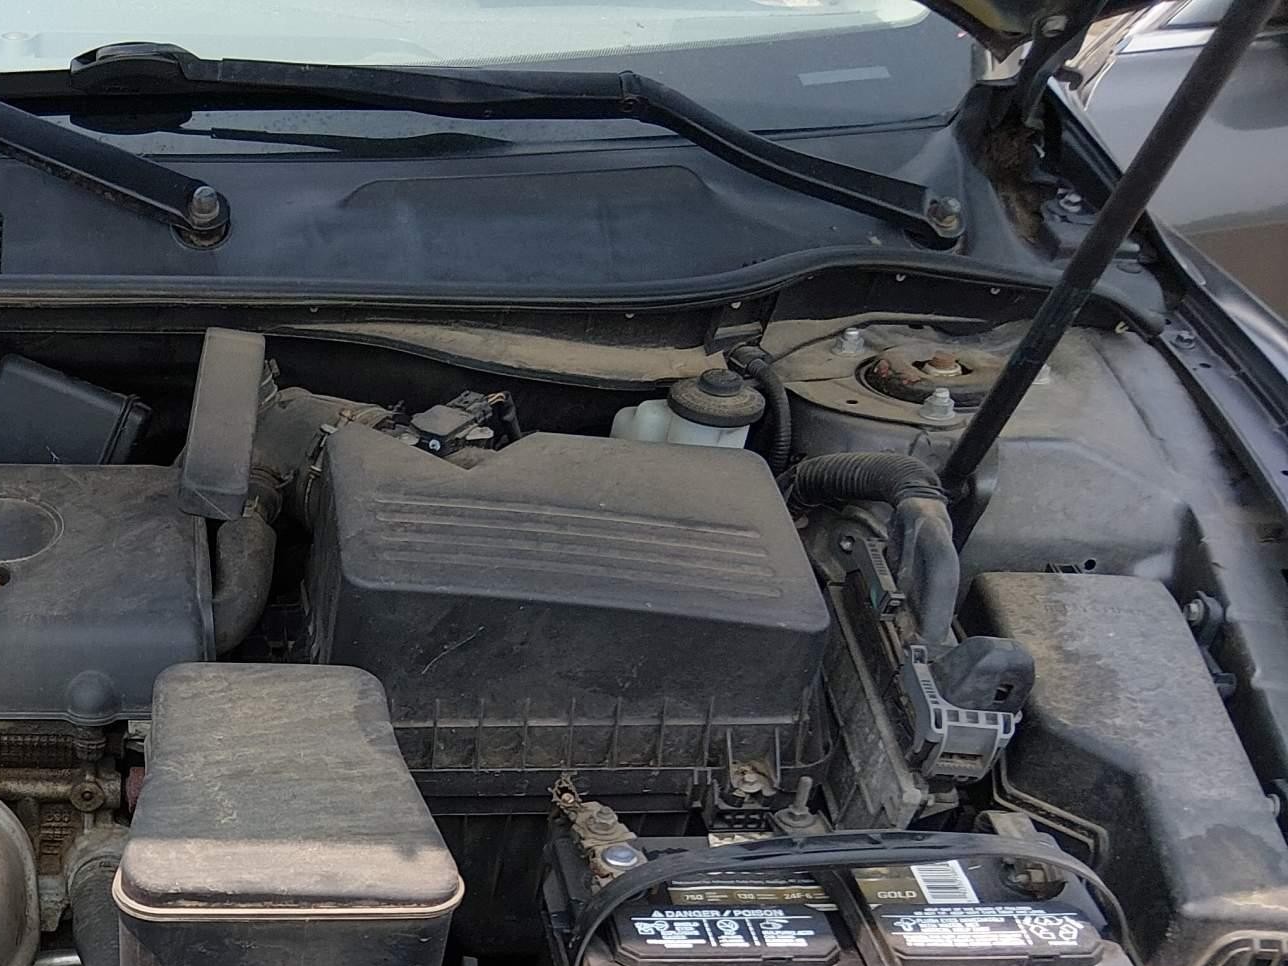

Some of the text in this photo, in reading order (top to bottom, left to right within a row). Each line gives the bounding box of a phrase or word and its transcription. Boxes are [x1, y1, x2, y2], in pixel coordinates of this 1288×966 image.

[877, 890, 918, 899] GOLD
[662, 910, 721, 918] DANGER
[733, 909, 785, 917] POISON
